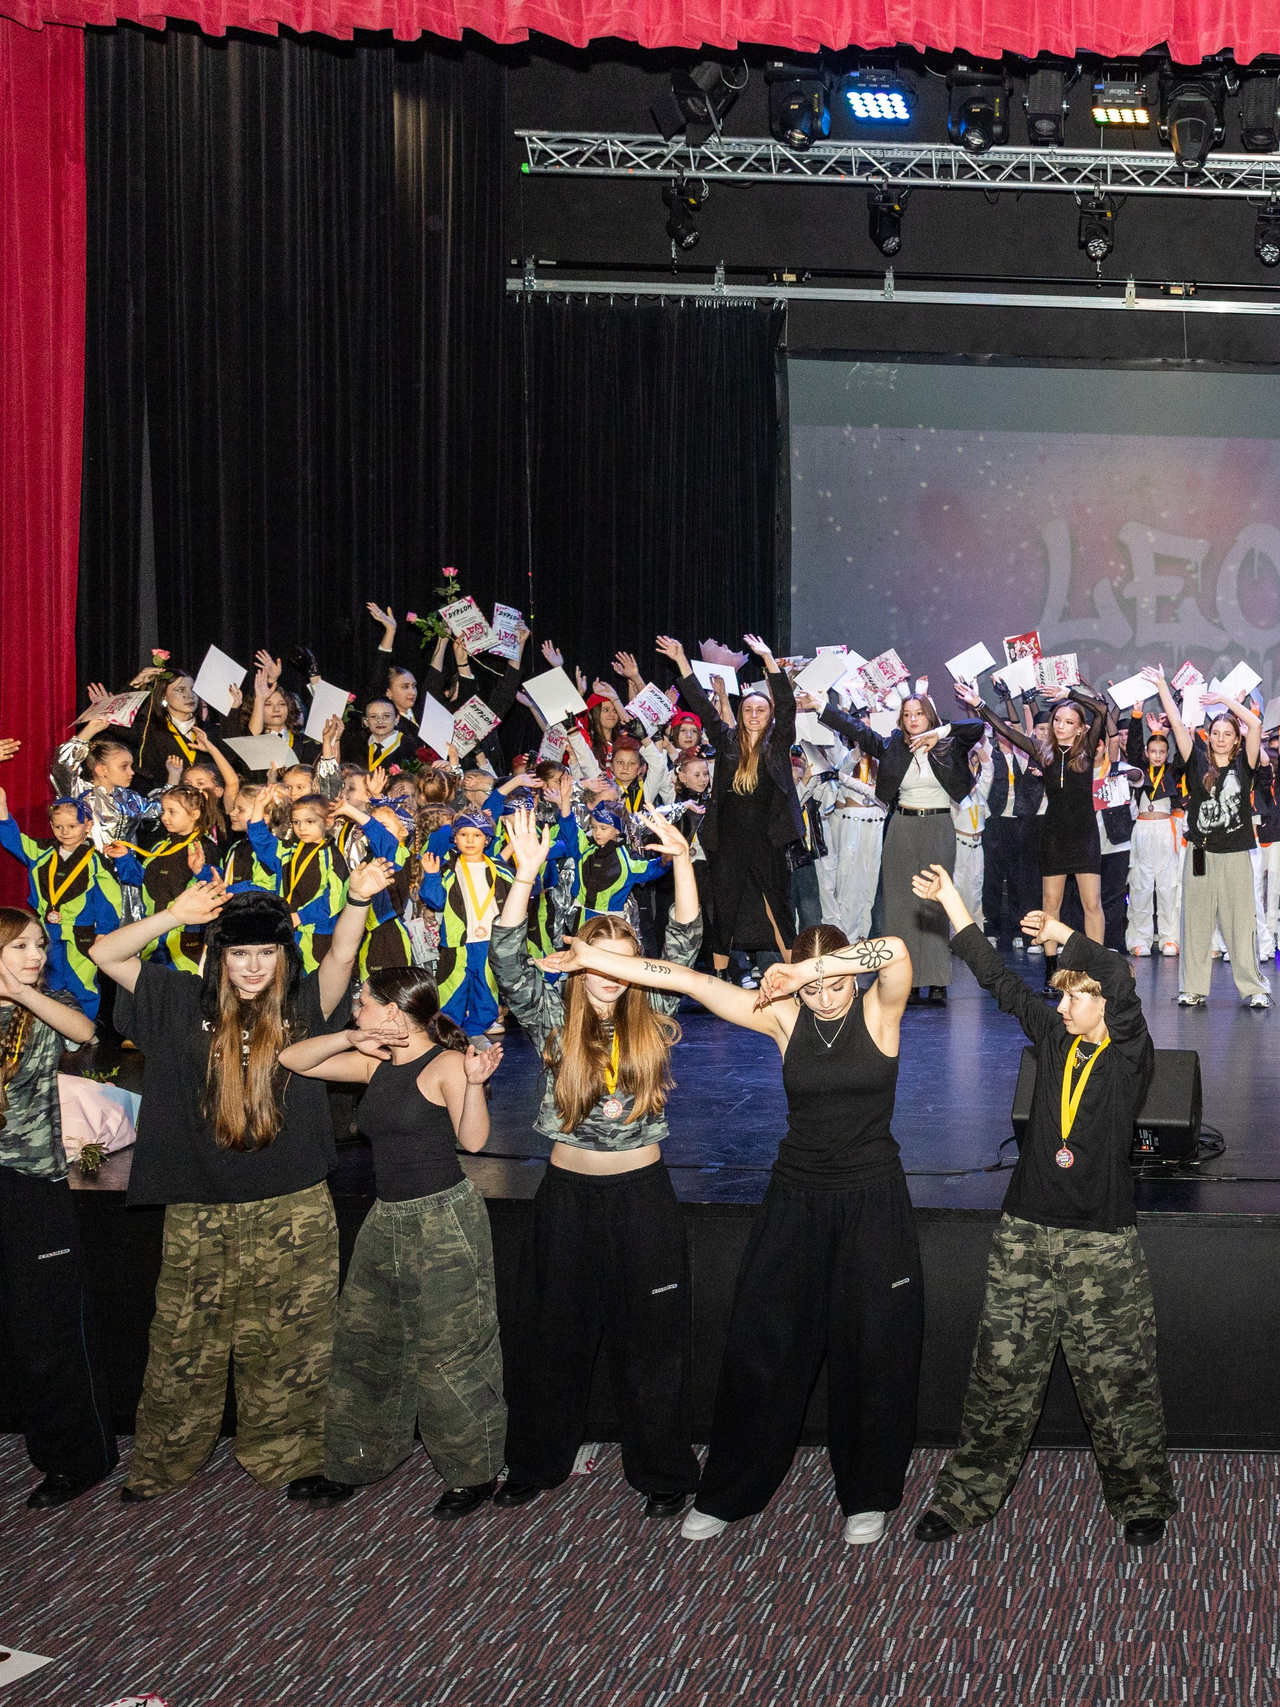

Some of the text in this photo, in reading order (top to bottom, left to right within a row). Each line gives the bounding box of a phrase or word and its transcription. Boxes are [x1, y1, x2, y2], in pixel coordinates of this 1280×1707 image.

[447, 603, 472, 619] DYPLOM
[462, 622, 484, 641] LEO
[470, 703, 493, 726] DYPLOM
